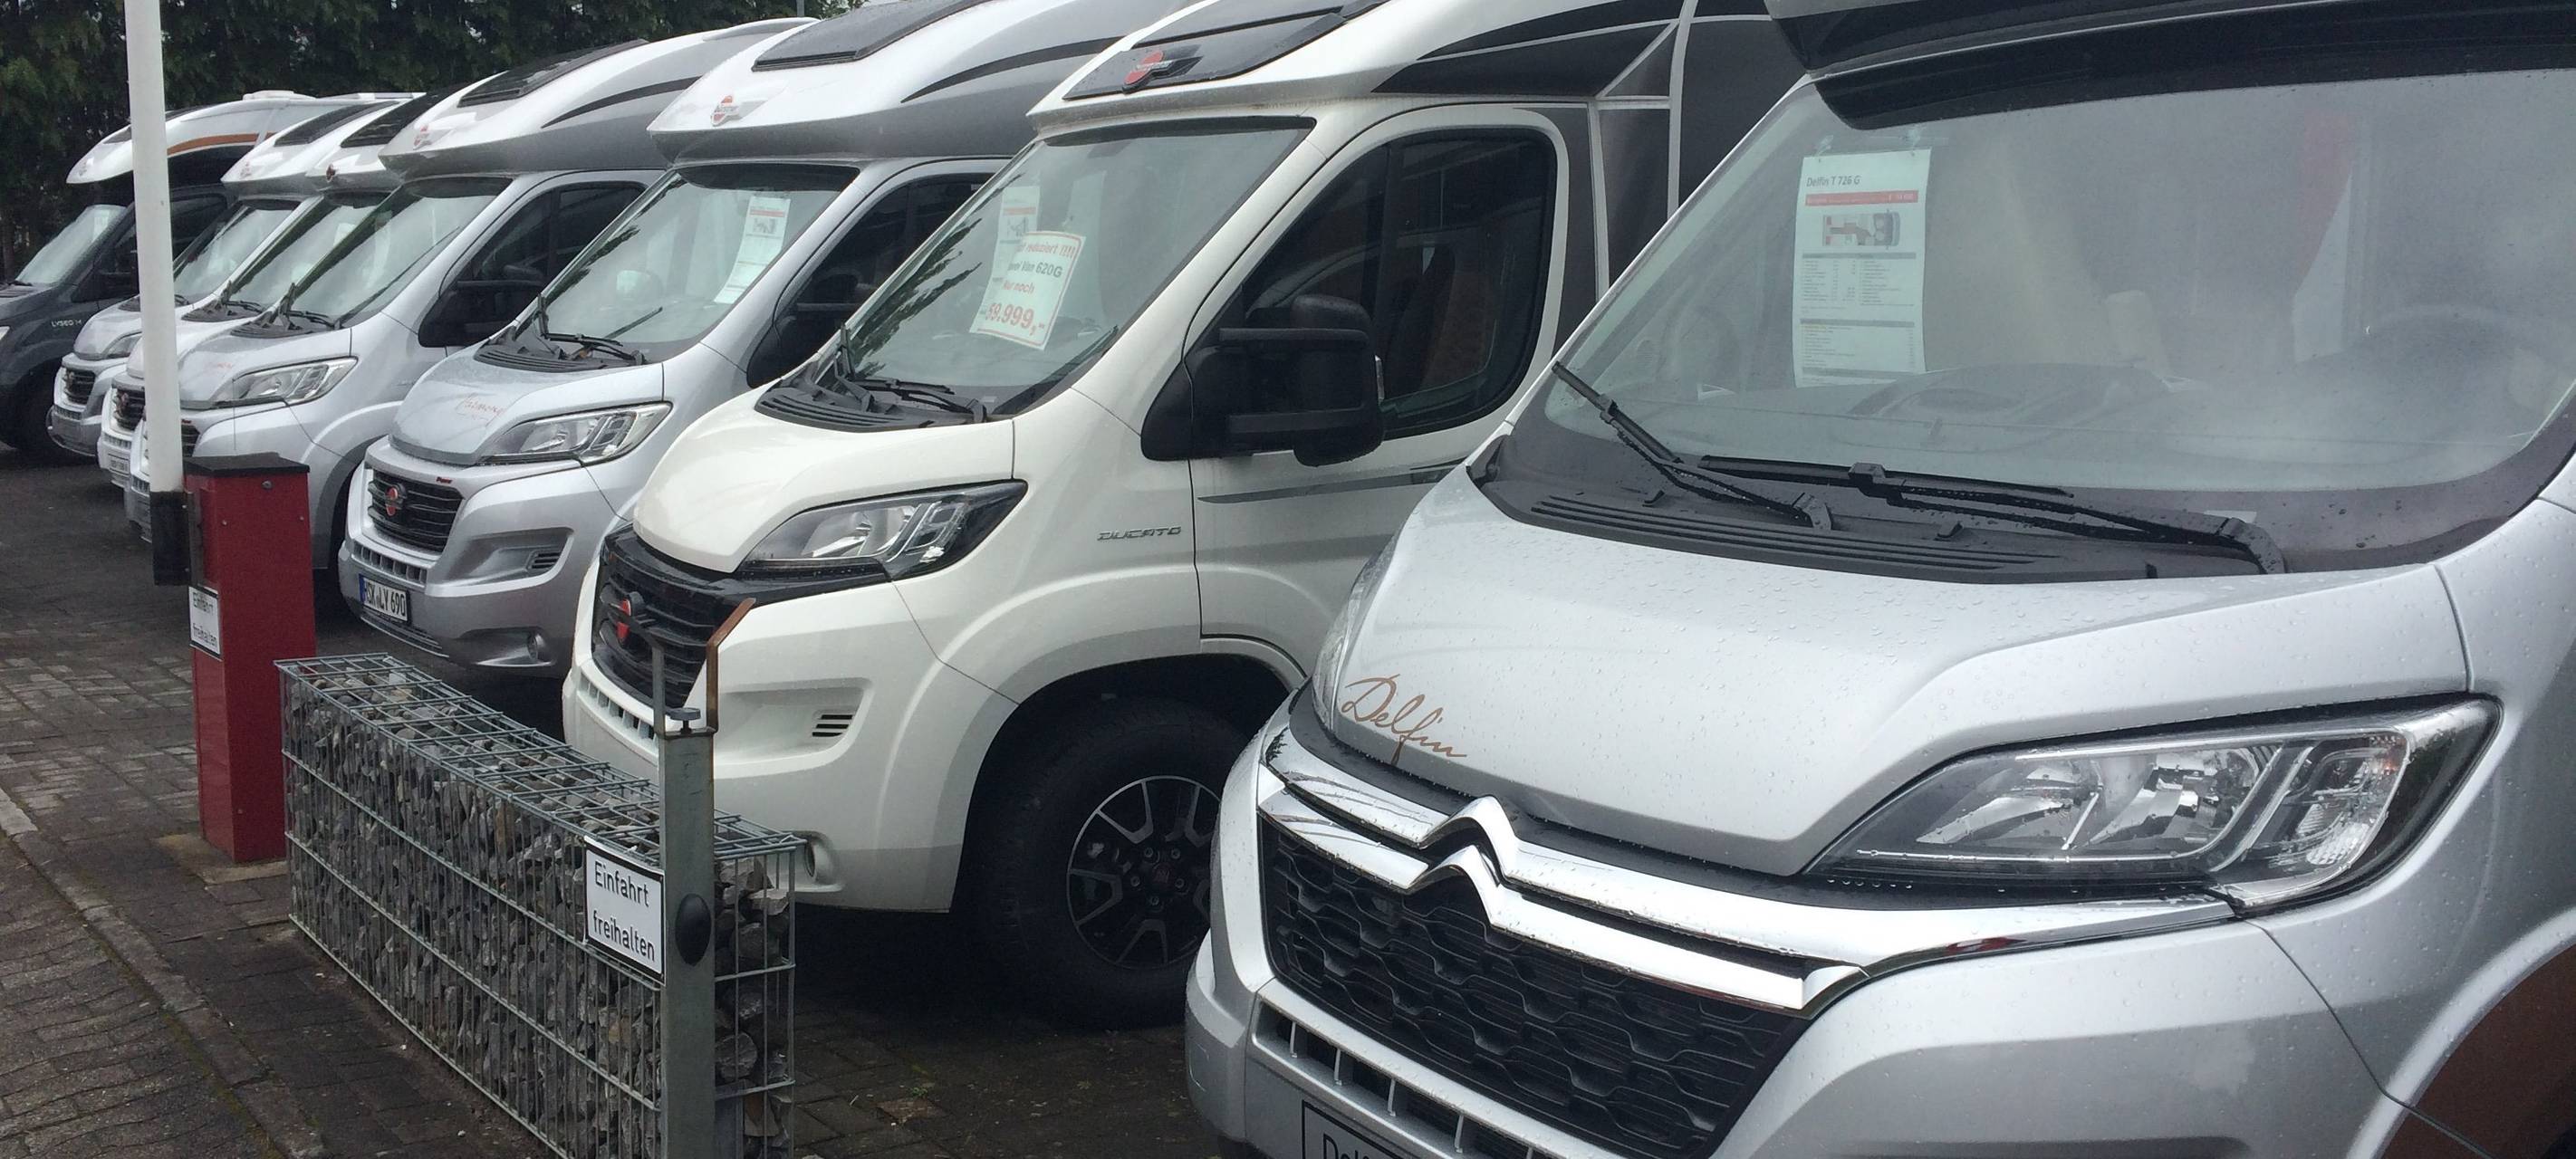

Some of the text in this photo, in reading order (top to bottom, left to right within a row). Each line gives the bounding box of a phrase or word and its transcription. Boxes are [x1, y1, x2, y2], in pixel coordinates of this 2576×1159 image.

[1806, 177, 1829, 187] Delfin
[1831, 176, 1836, 186] T
[1853, 175, 1862, 185] G
[1035, 262, 1063, 278] 620G
[1014, 282, 1035, 294] noch
[1097, 526, 1182, 541] DUCATO
[1341, 673, 1467, 766] Delfin
[594, 860, 649, 907] Einfahrt
[593, 910, 655, 963] freihalten
